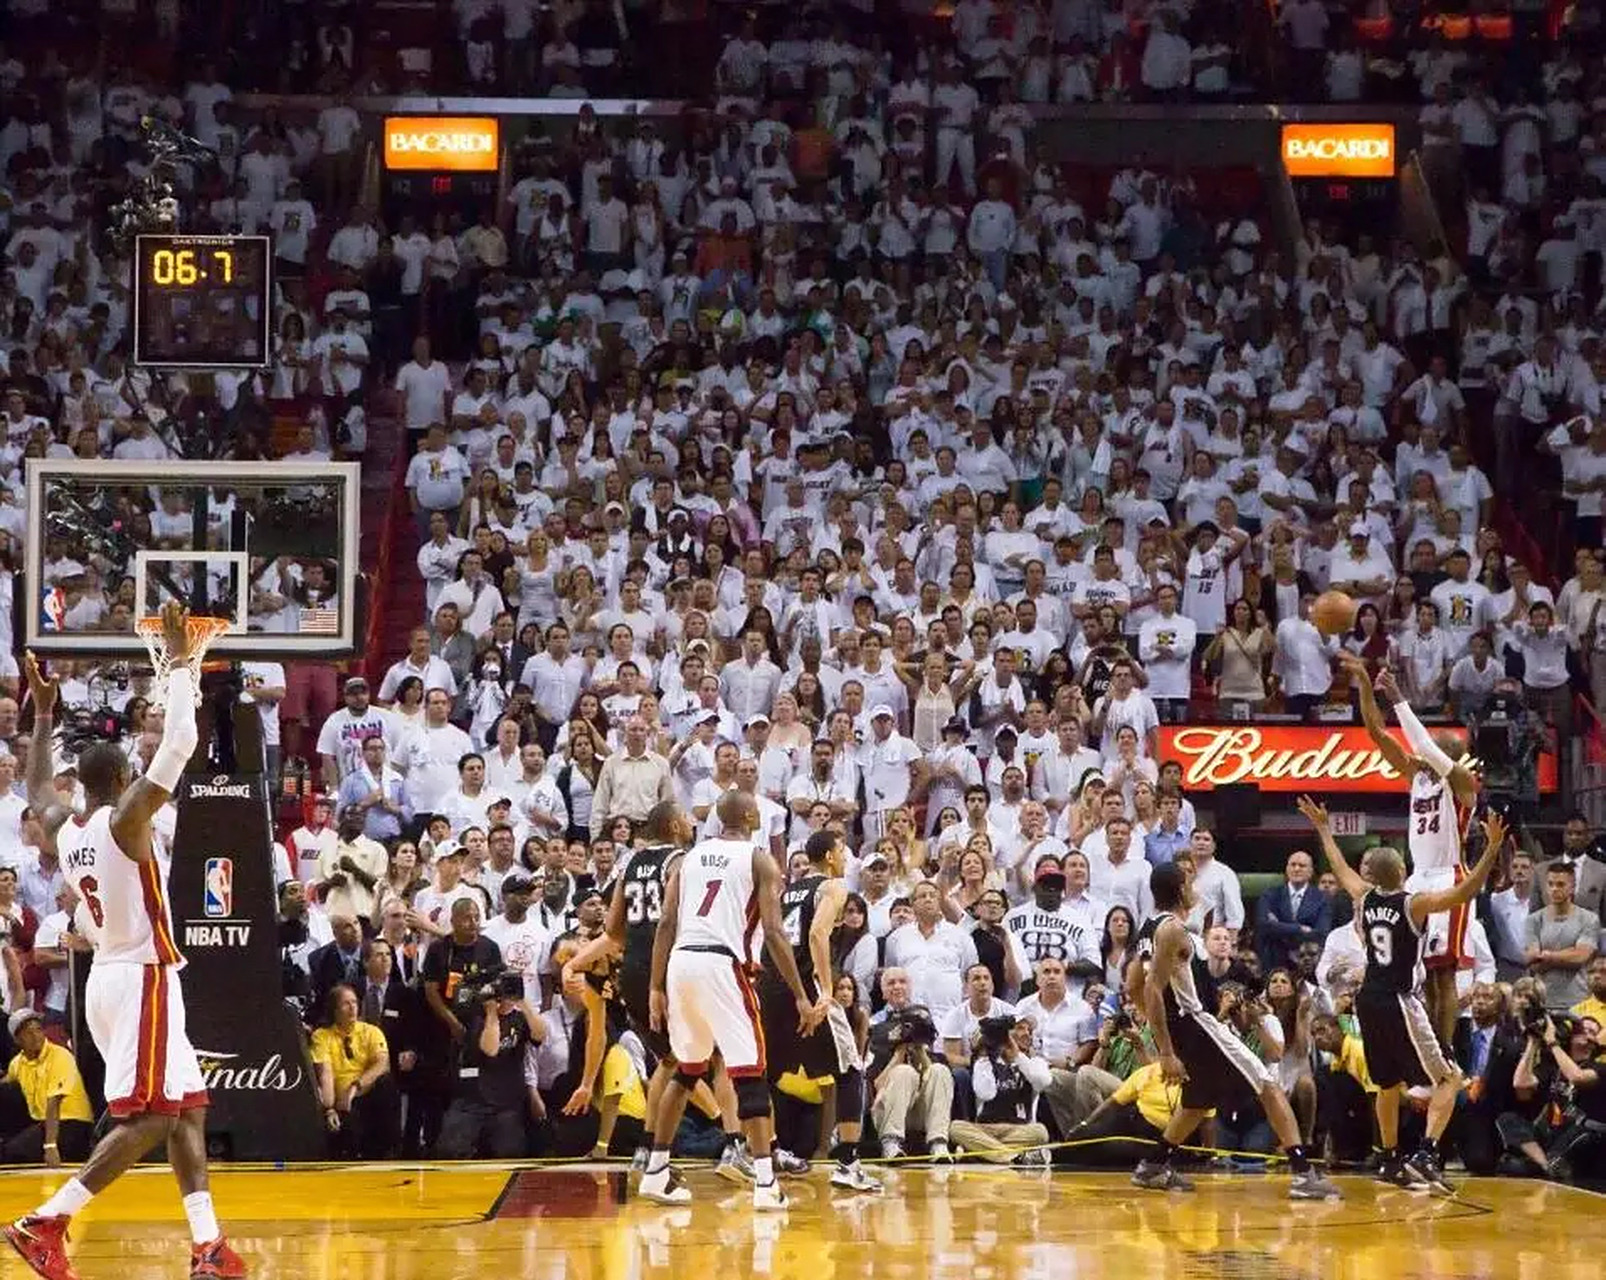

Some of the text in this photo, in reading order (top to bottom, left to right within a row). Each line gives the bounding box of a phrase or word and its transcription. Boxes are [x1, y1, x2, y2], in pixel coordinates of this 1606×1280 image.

[390, 133, 493, 152] BACARDI
[1287, 138, 1390, 158] BACARDI
[153, 250, 232, 284] 06.7
[190, 784, 250, 799] SPALDING
[1417, 814, 1440, 835] 34
[79, 875, 104, 928] 6
[625, 880, 662, 922] 33
[696, 879, 722, 917] 1
[185, 926, 251, 947] NBA TV
[1370, 926, 1393, 966] 9
[193, 1048, 302, 1091] inals
